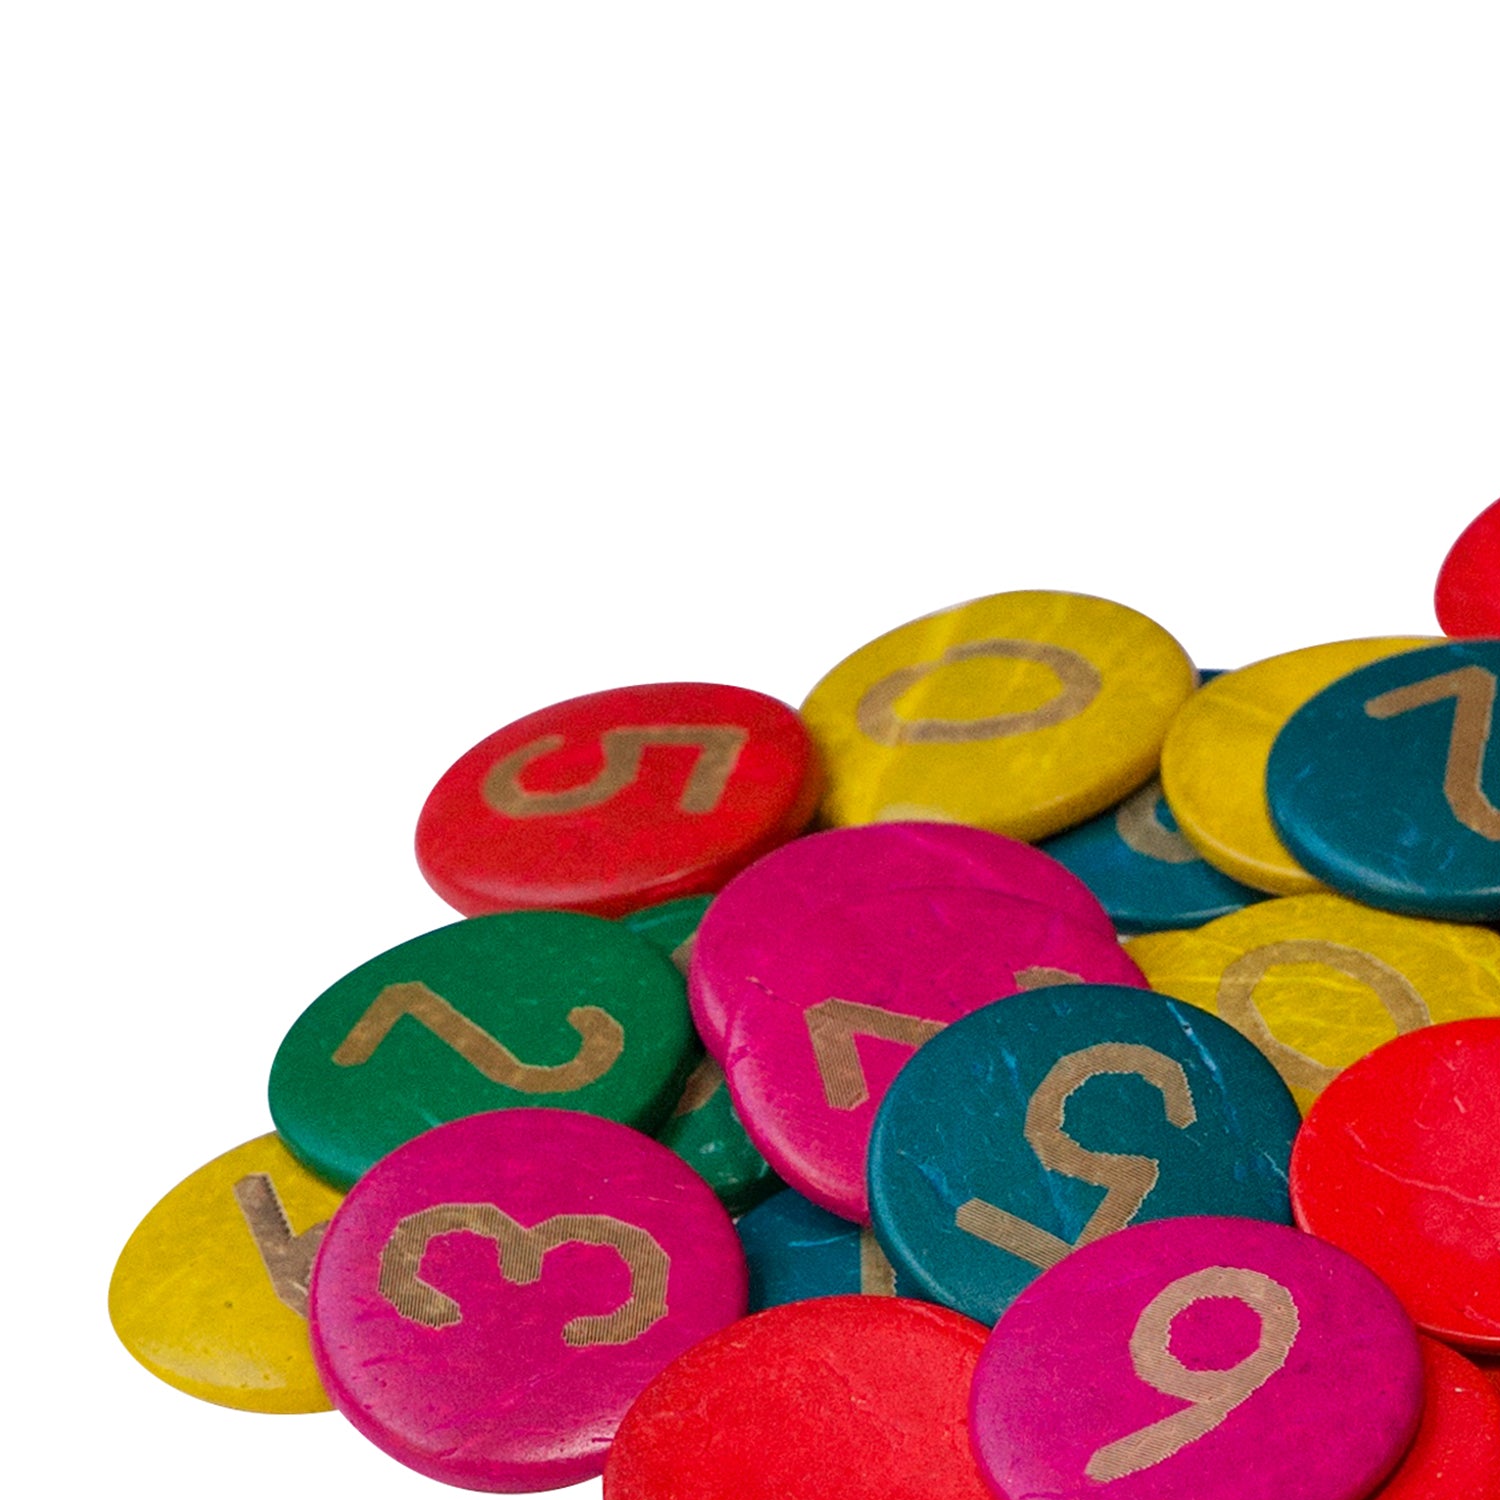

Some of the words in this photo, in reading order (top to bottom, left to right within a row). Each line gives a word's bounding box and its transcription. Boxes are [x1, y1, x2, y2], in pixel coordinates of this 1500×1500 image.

[855, 638, 1102, 746] 0
[482, 725, 749, 819] 5
[331, 980, 624, 1093] 2
[1216, 939, 1431, 1094] 0
[956, 1042, 1197, 1272] 5
[378, 1202, 670, 1347] 3
